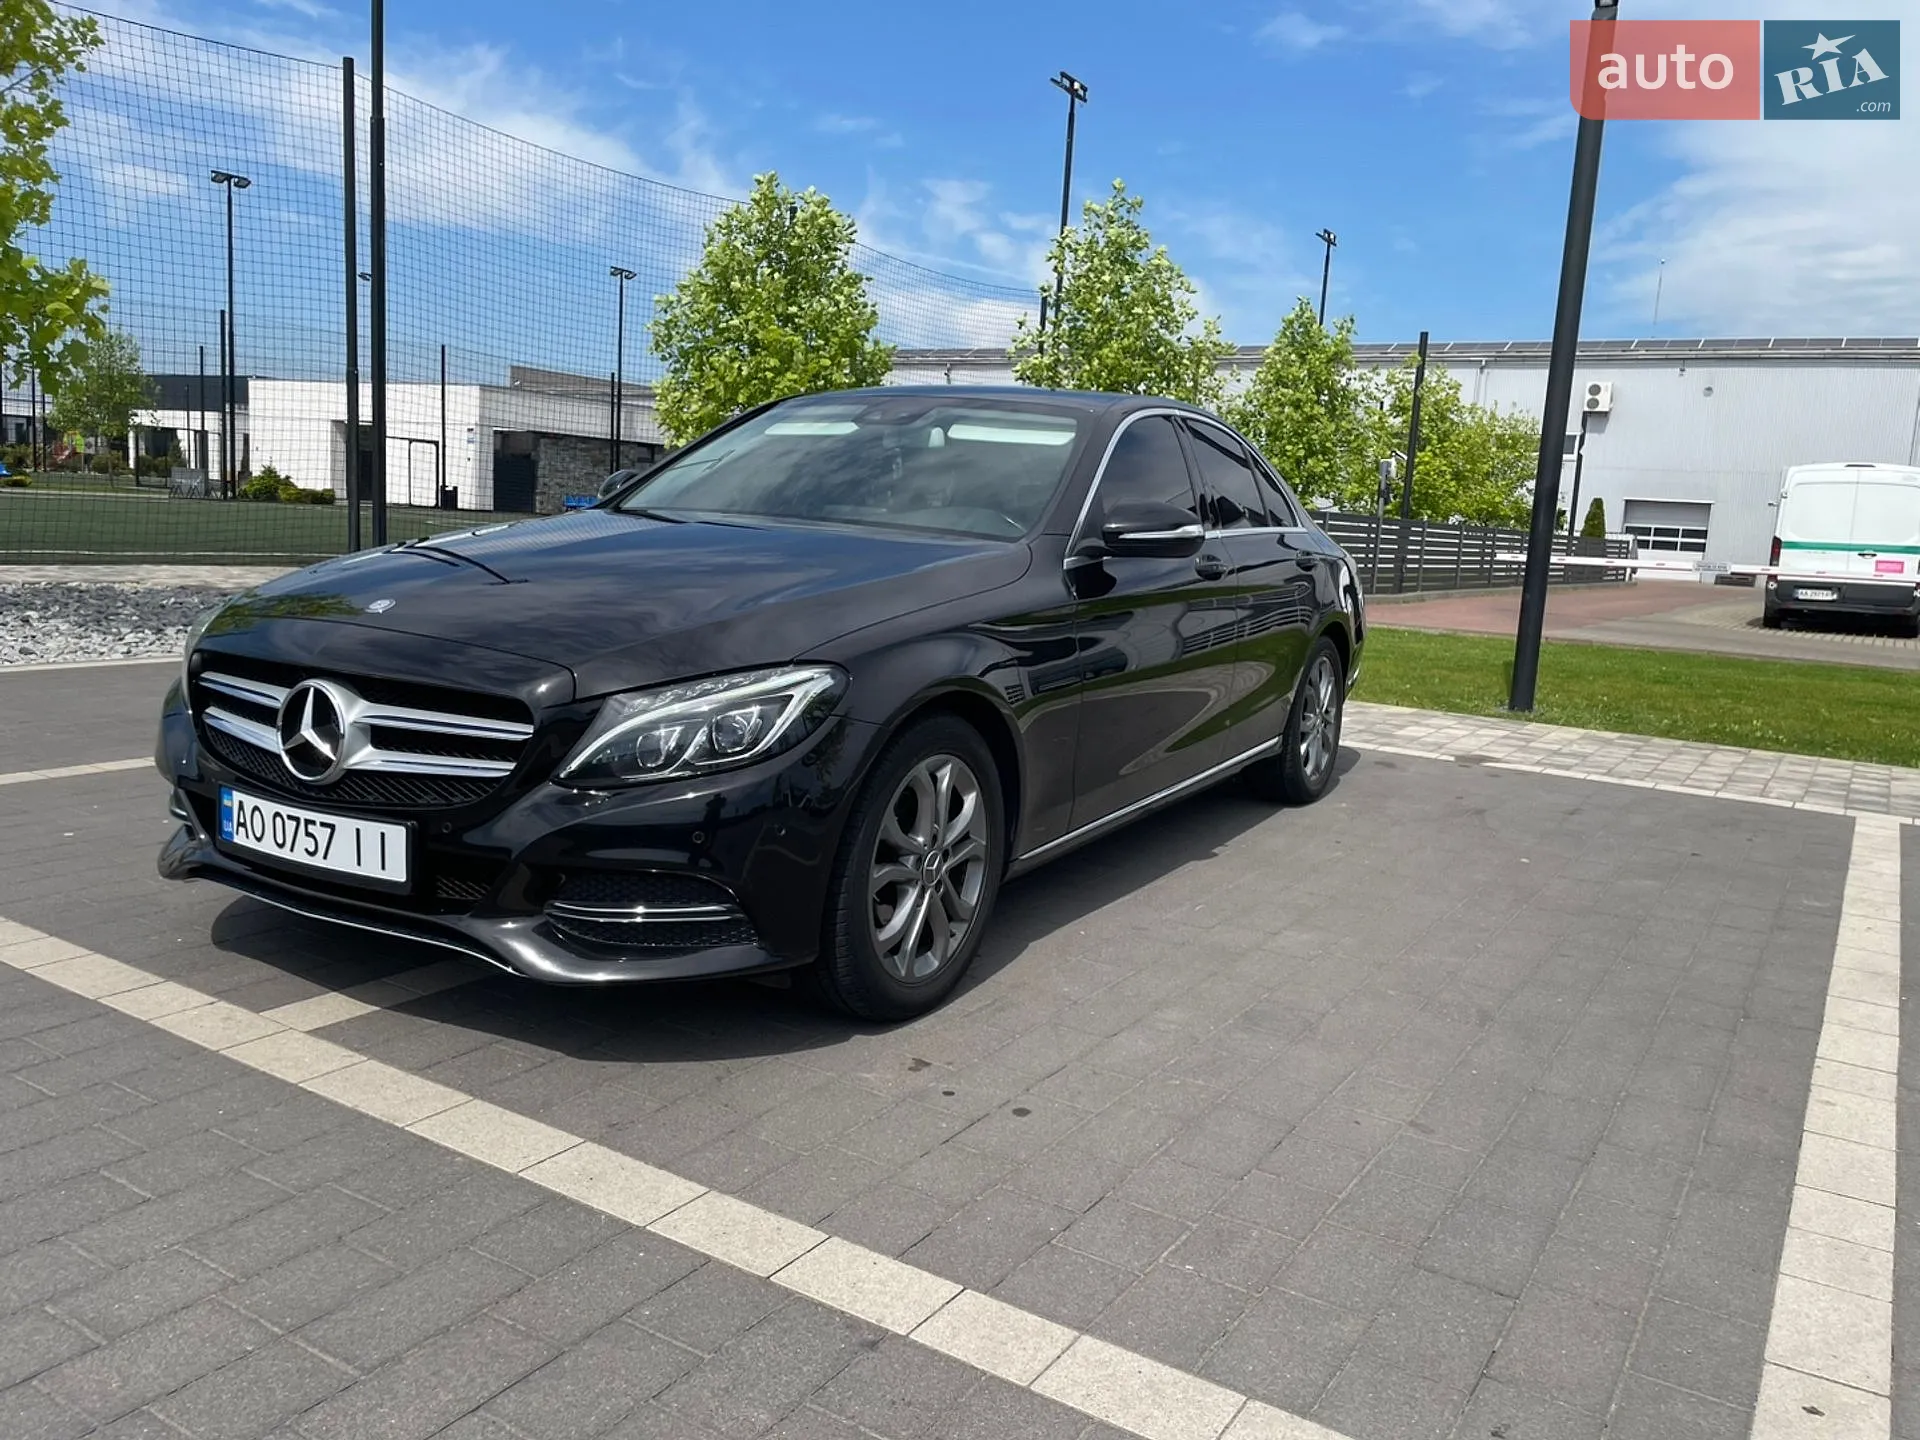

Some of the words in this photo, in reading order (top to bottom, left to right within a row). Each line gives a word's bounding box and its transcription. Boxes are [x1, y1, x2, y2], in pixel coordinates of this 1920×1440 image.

[236, 800, 266, 842] AO
[272, 811, 336, 860] 0757
[354, 827, 387, 871] II
